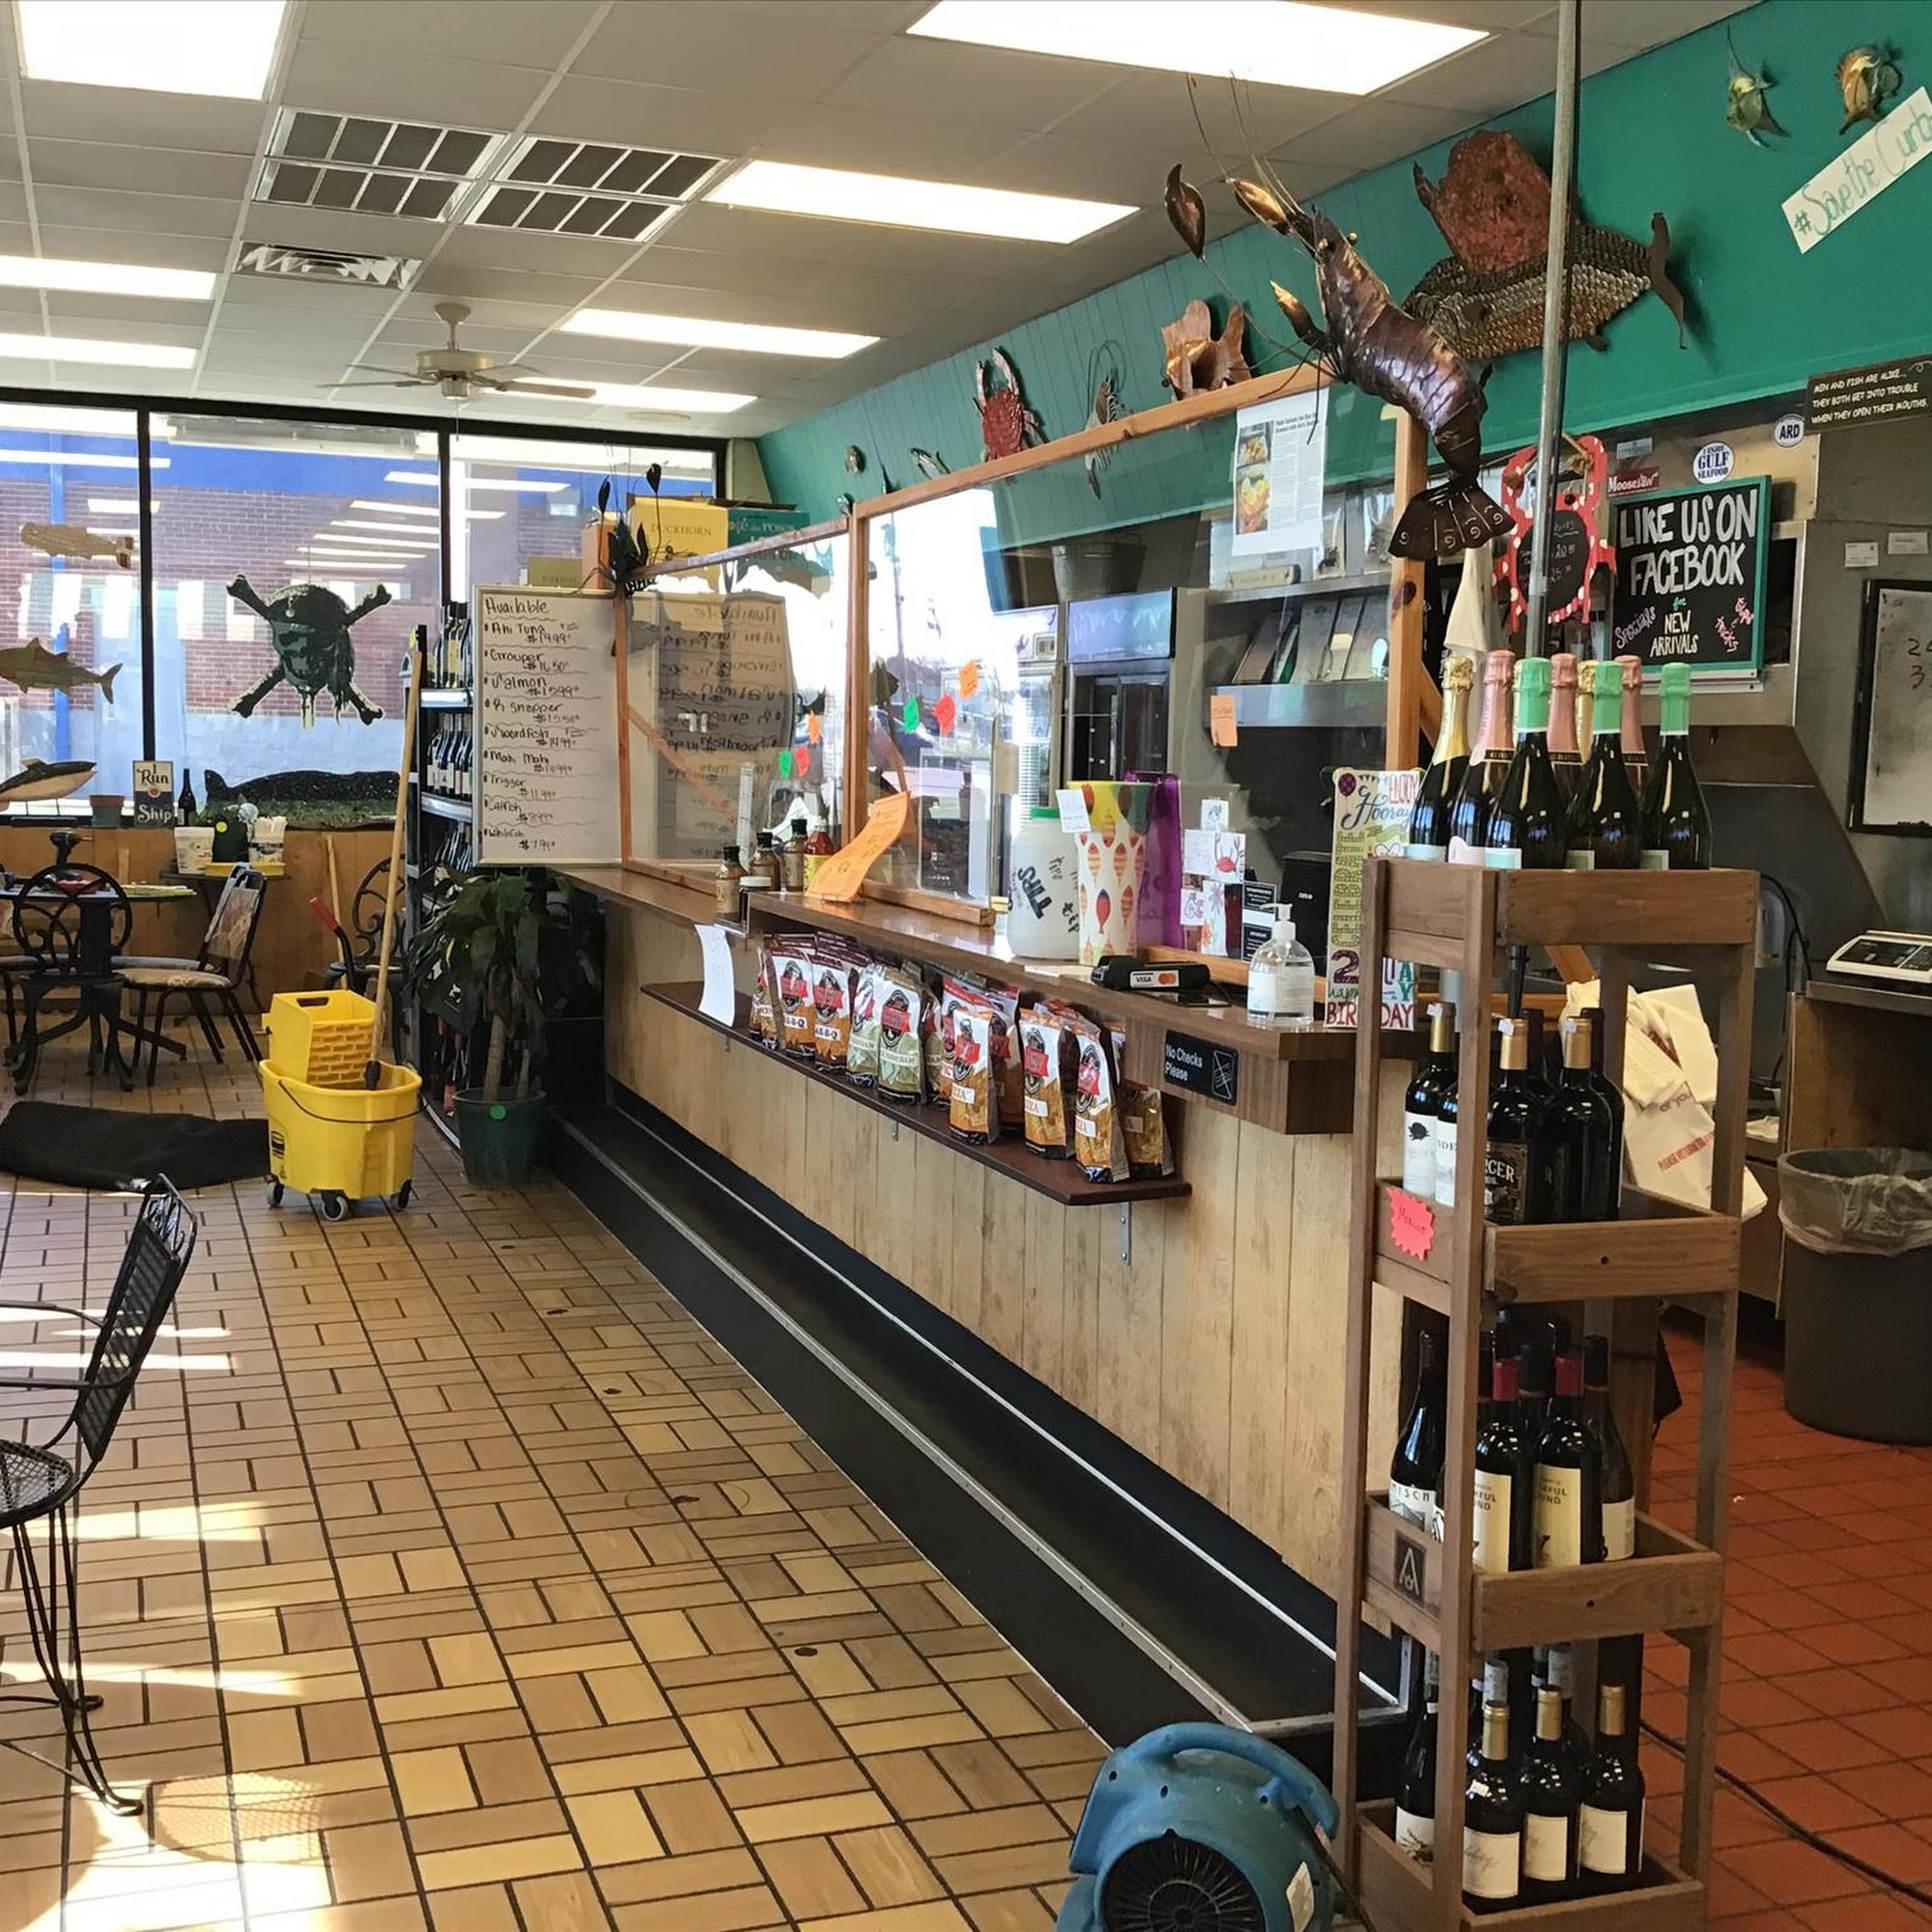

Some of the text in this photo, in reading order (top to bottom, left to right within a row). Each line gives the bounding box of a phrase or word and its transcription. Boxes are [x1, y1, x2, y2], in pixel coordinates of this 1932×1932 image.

[1831, 380, 1845, 390] AND
[1846, 376, 1863, 386] FISH
[1864, 373, 1879, 384] ARE
[1812, 383, 1919, 409] THEY BOTH GET INTO TROUBLE
[1811, 412, 1833, 424] WHEN
[1833, 410, 1852, 420] THEY
[1852, 406, 1872, 417] OPEN
[1872, 403, 1894, 413] THEIR
[1779, 424, 1800, 440] ARD
[1698, 451, 1729, 469] GULF
[1697, 467, 1729, 479] SEAFOOD
[1620, 489, 1758, 549] LIKE US ON
[1630, 542, 1746, 597] FACEBOOK
[485, 597, 549, 614] Available
[518, 623, 546, 635] Tuna
[1664, 610, 1691, 635] NEW
[1649, 634, 1699, 657] ARRIVALS
[490, 648, 545, 664] Grouper
[137, 767, 169, 786] Run
[137, 805, 172, 823] Ship
[1166, 1044, 1203, 1068] No Checks
[1165, 1062, 1188, 1081] Please
